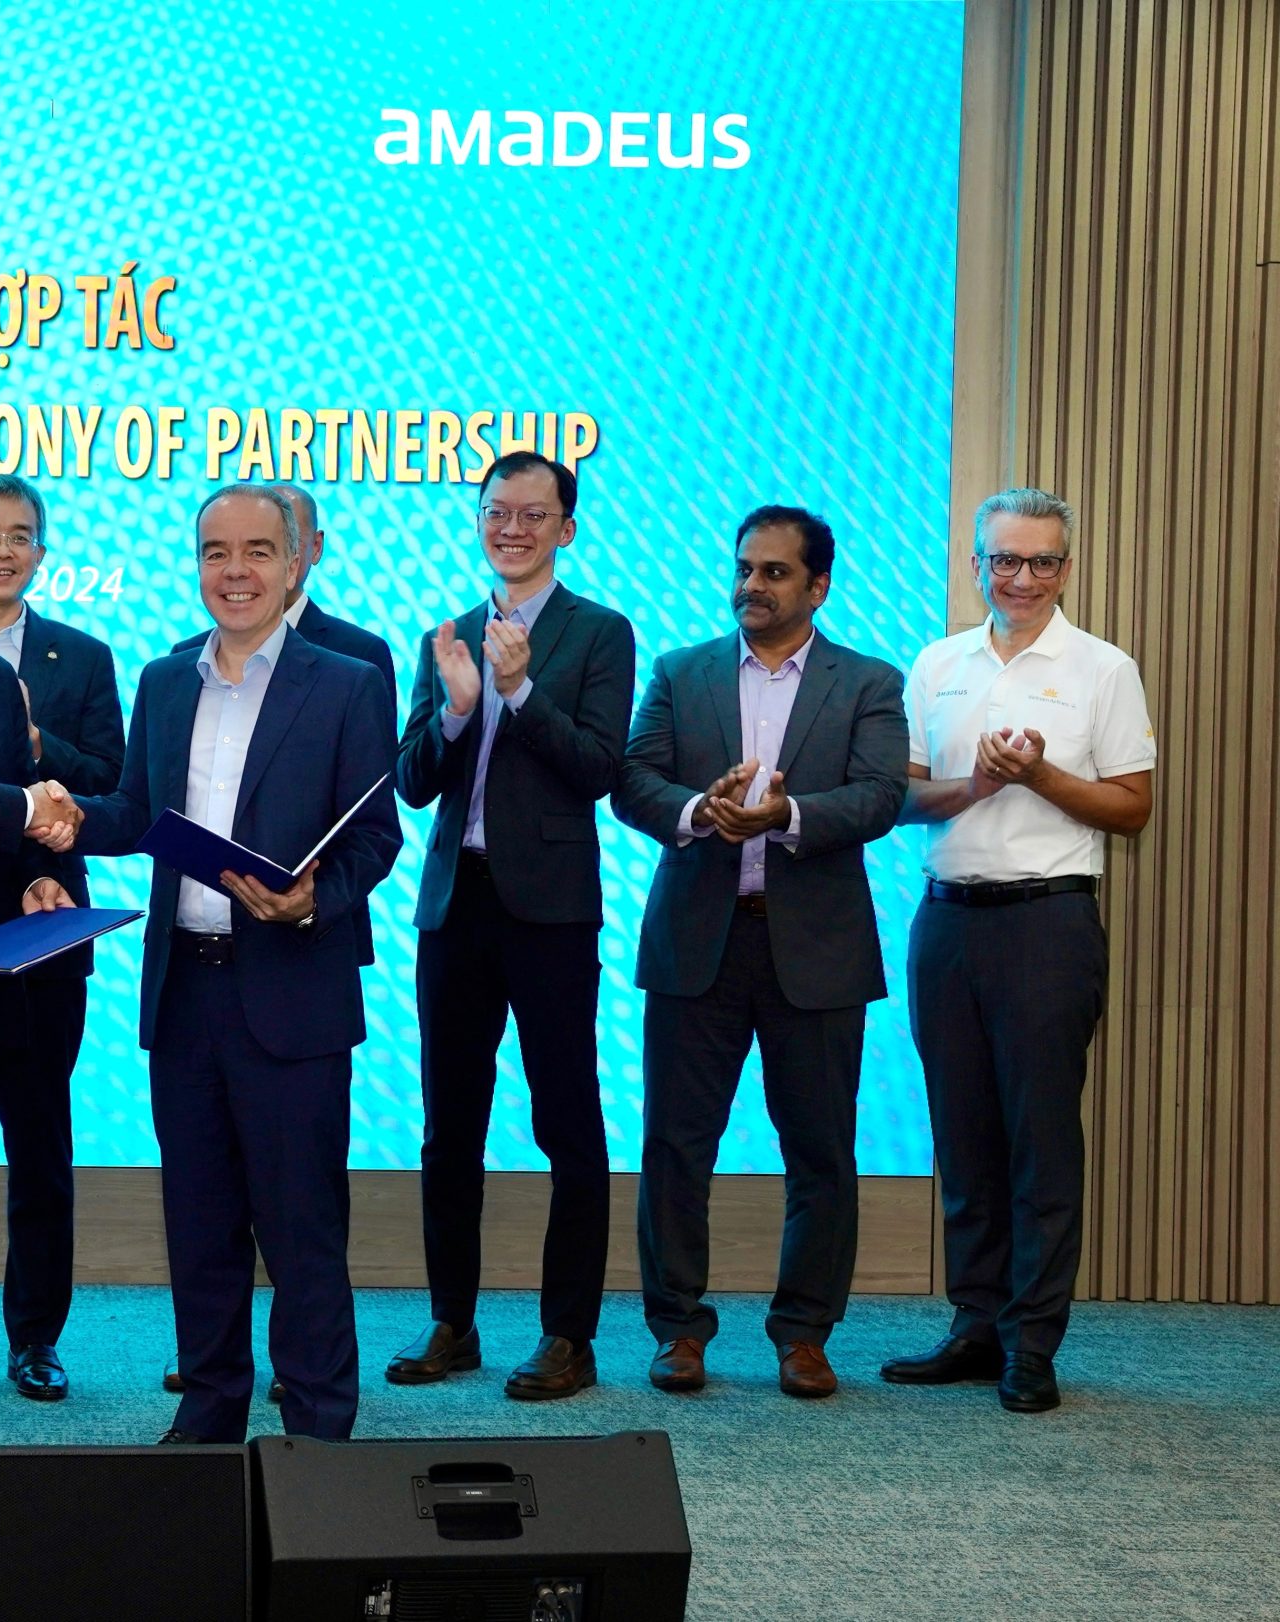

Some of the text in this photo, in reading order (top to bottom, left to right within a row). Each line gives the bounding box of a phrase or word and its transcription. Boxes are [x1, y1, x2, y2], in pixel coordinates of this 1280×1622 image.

[75, 261, 176, 349] TÁC
[114, 405, 186, 479] OF
[206, 407, 599, 484] PARTNERSHIP
[24, 564, 125, 602] 2024
